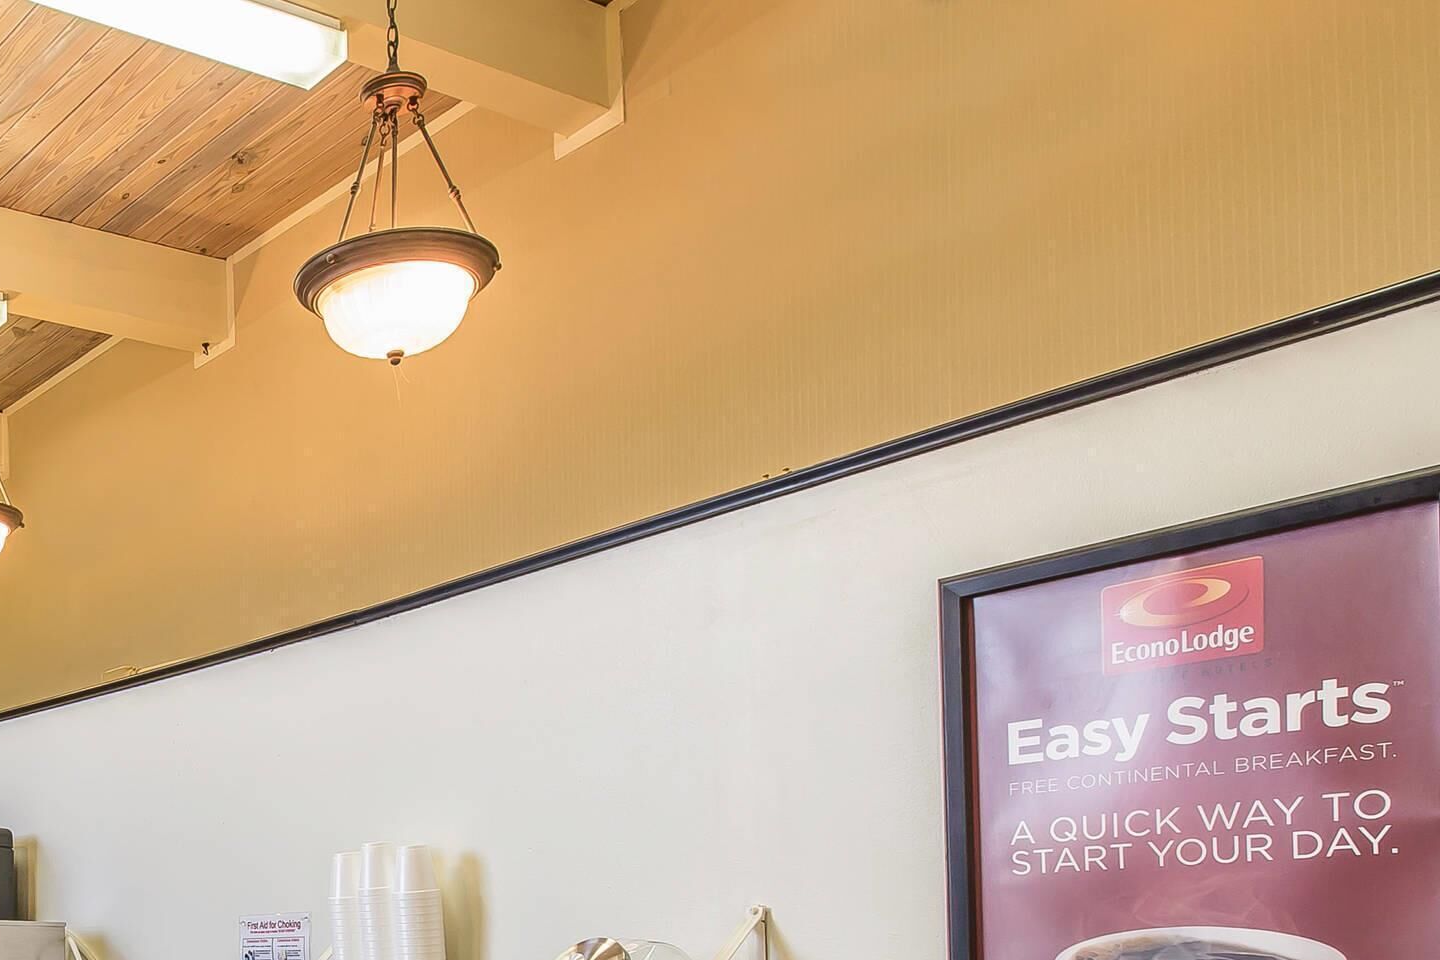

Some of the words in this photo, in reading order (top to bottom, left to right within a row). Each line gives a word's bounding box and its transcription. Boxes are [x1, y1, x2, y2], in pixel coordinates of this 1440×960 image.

[1007, 712, 1150, 766] Easy
[1008, 778, 1059, 796] FREE
[1067, 761, 1225, 791] CONTINENTAL
[1234, 741, 1398, 773] BREAKFAST.
[1011, 820, 1035, 846] A
[1050, 806, 1182, 843] QUICK
[1197, 796, 1305, 830] WAY
[1322, 789, 1392, 822] TO
[1011, 842, 1133, 876] START
[1148, 832, 1274, 867] YOUR
[1292, 824, 1400, 860] DAY.
[247, 921, 259, 930] First
[259, 921, 269, 929] Aid
[269, 920, 277, 929] for
[277, 920, 301, 930] Choking
